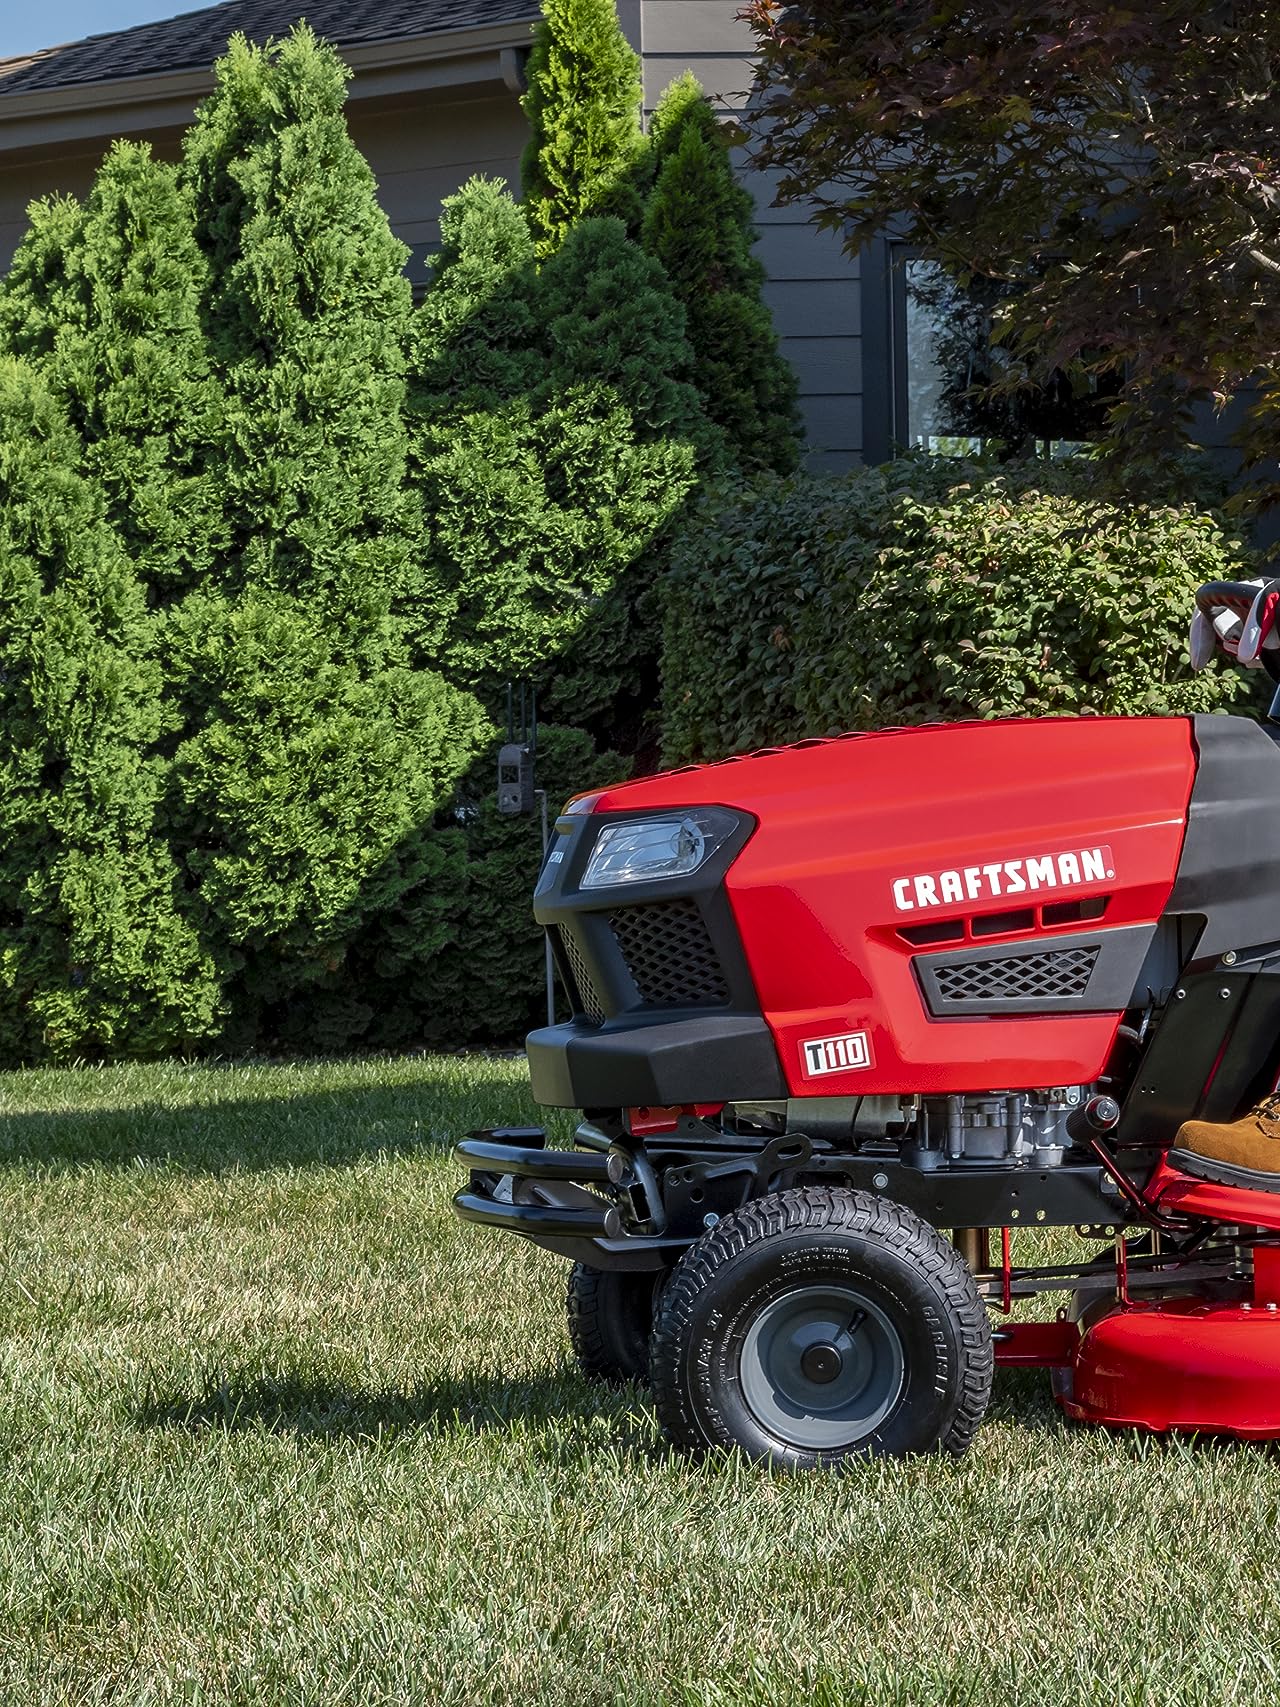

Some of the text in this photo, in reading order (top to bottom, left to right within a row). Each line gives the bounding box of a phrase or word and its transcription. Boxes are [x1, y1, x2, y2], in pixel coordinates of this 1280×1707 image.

[893, 848, 1106, 911] CRAFTSMAN
[806, 1036, 865, 1071] T110
[922, 1306, 948, 1400] CARLISLE
